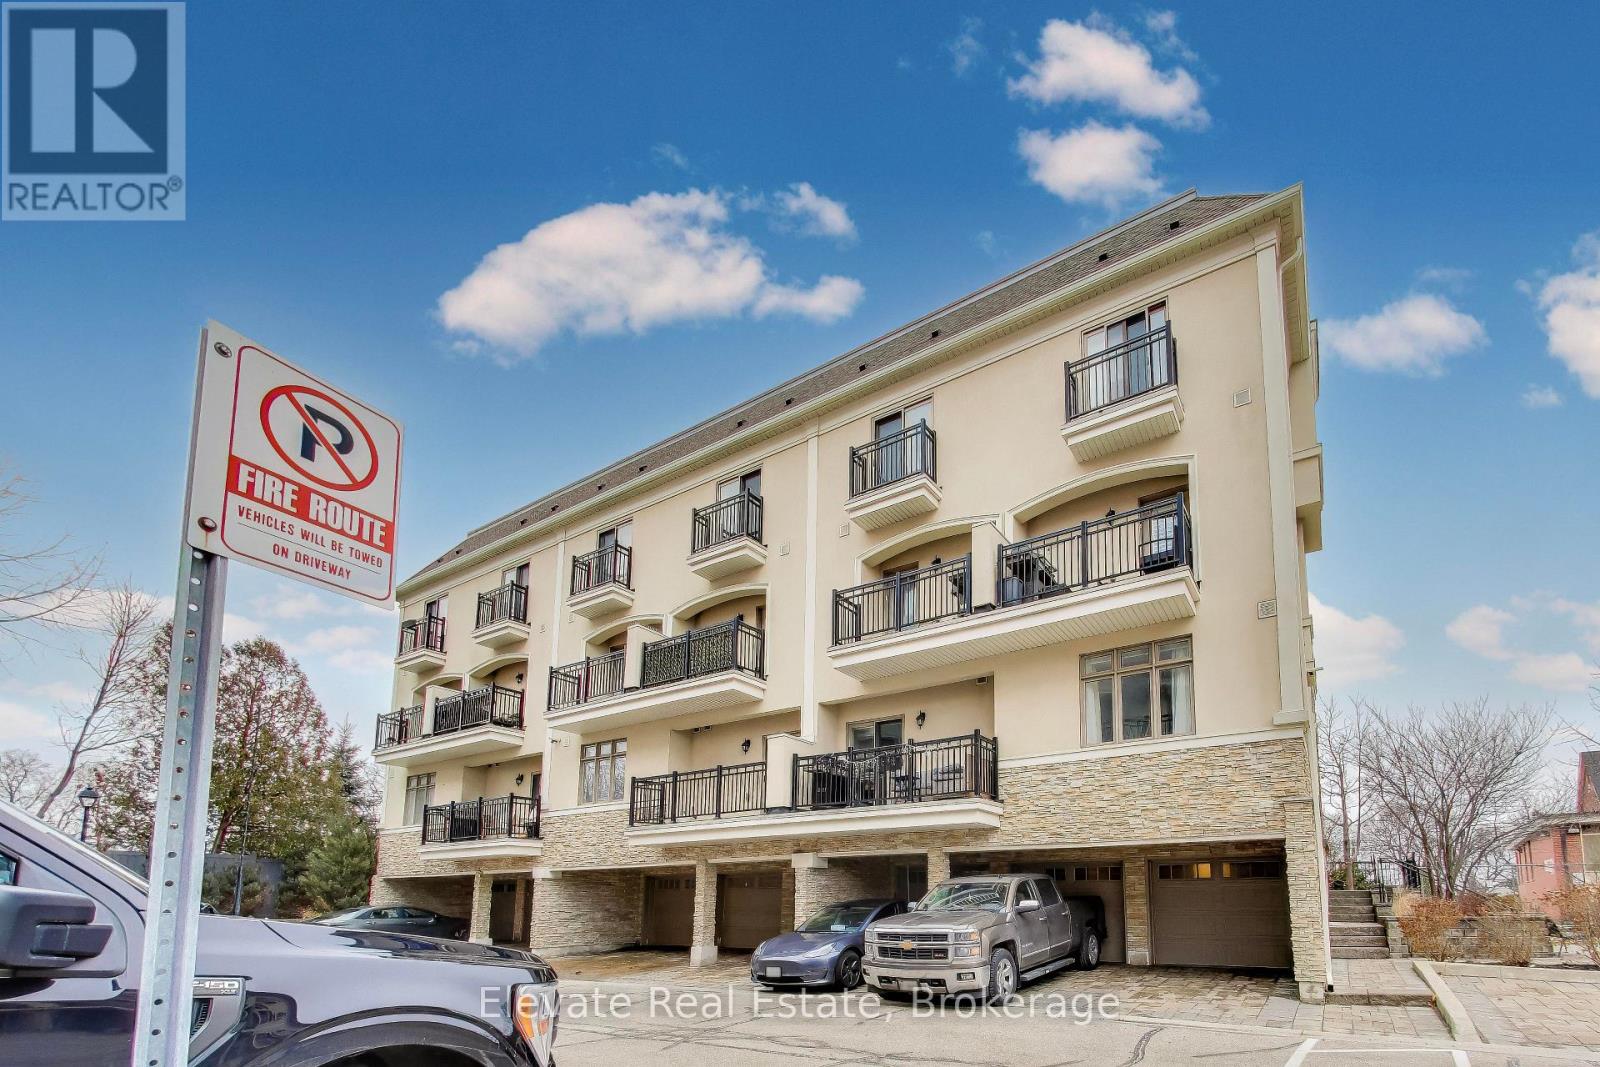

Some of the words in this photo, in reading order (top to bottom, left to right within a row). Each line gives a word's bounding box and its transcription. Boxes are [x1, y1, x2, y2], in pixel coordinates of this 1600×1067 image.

[238, 462, 299, 513] FIRE
[309, 491, 386, 547] ROUTE
[238, 505, 295, 536] VEHICLES
[300, 528, 326, 548] WILL
[331, 539, 343, 554] BE
[348, 546, 383, 568] TOWED
[272, 543, 289, 559] ON
[294, 551, 352, 580] DRIVEWAY
